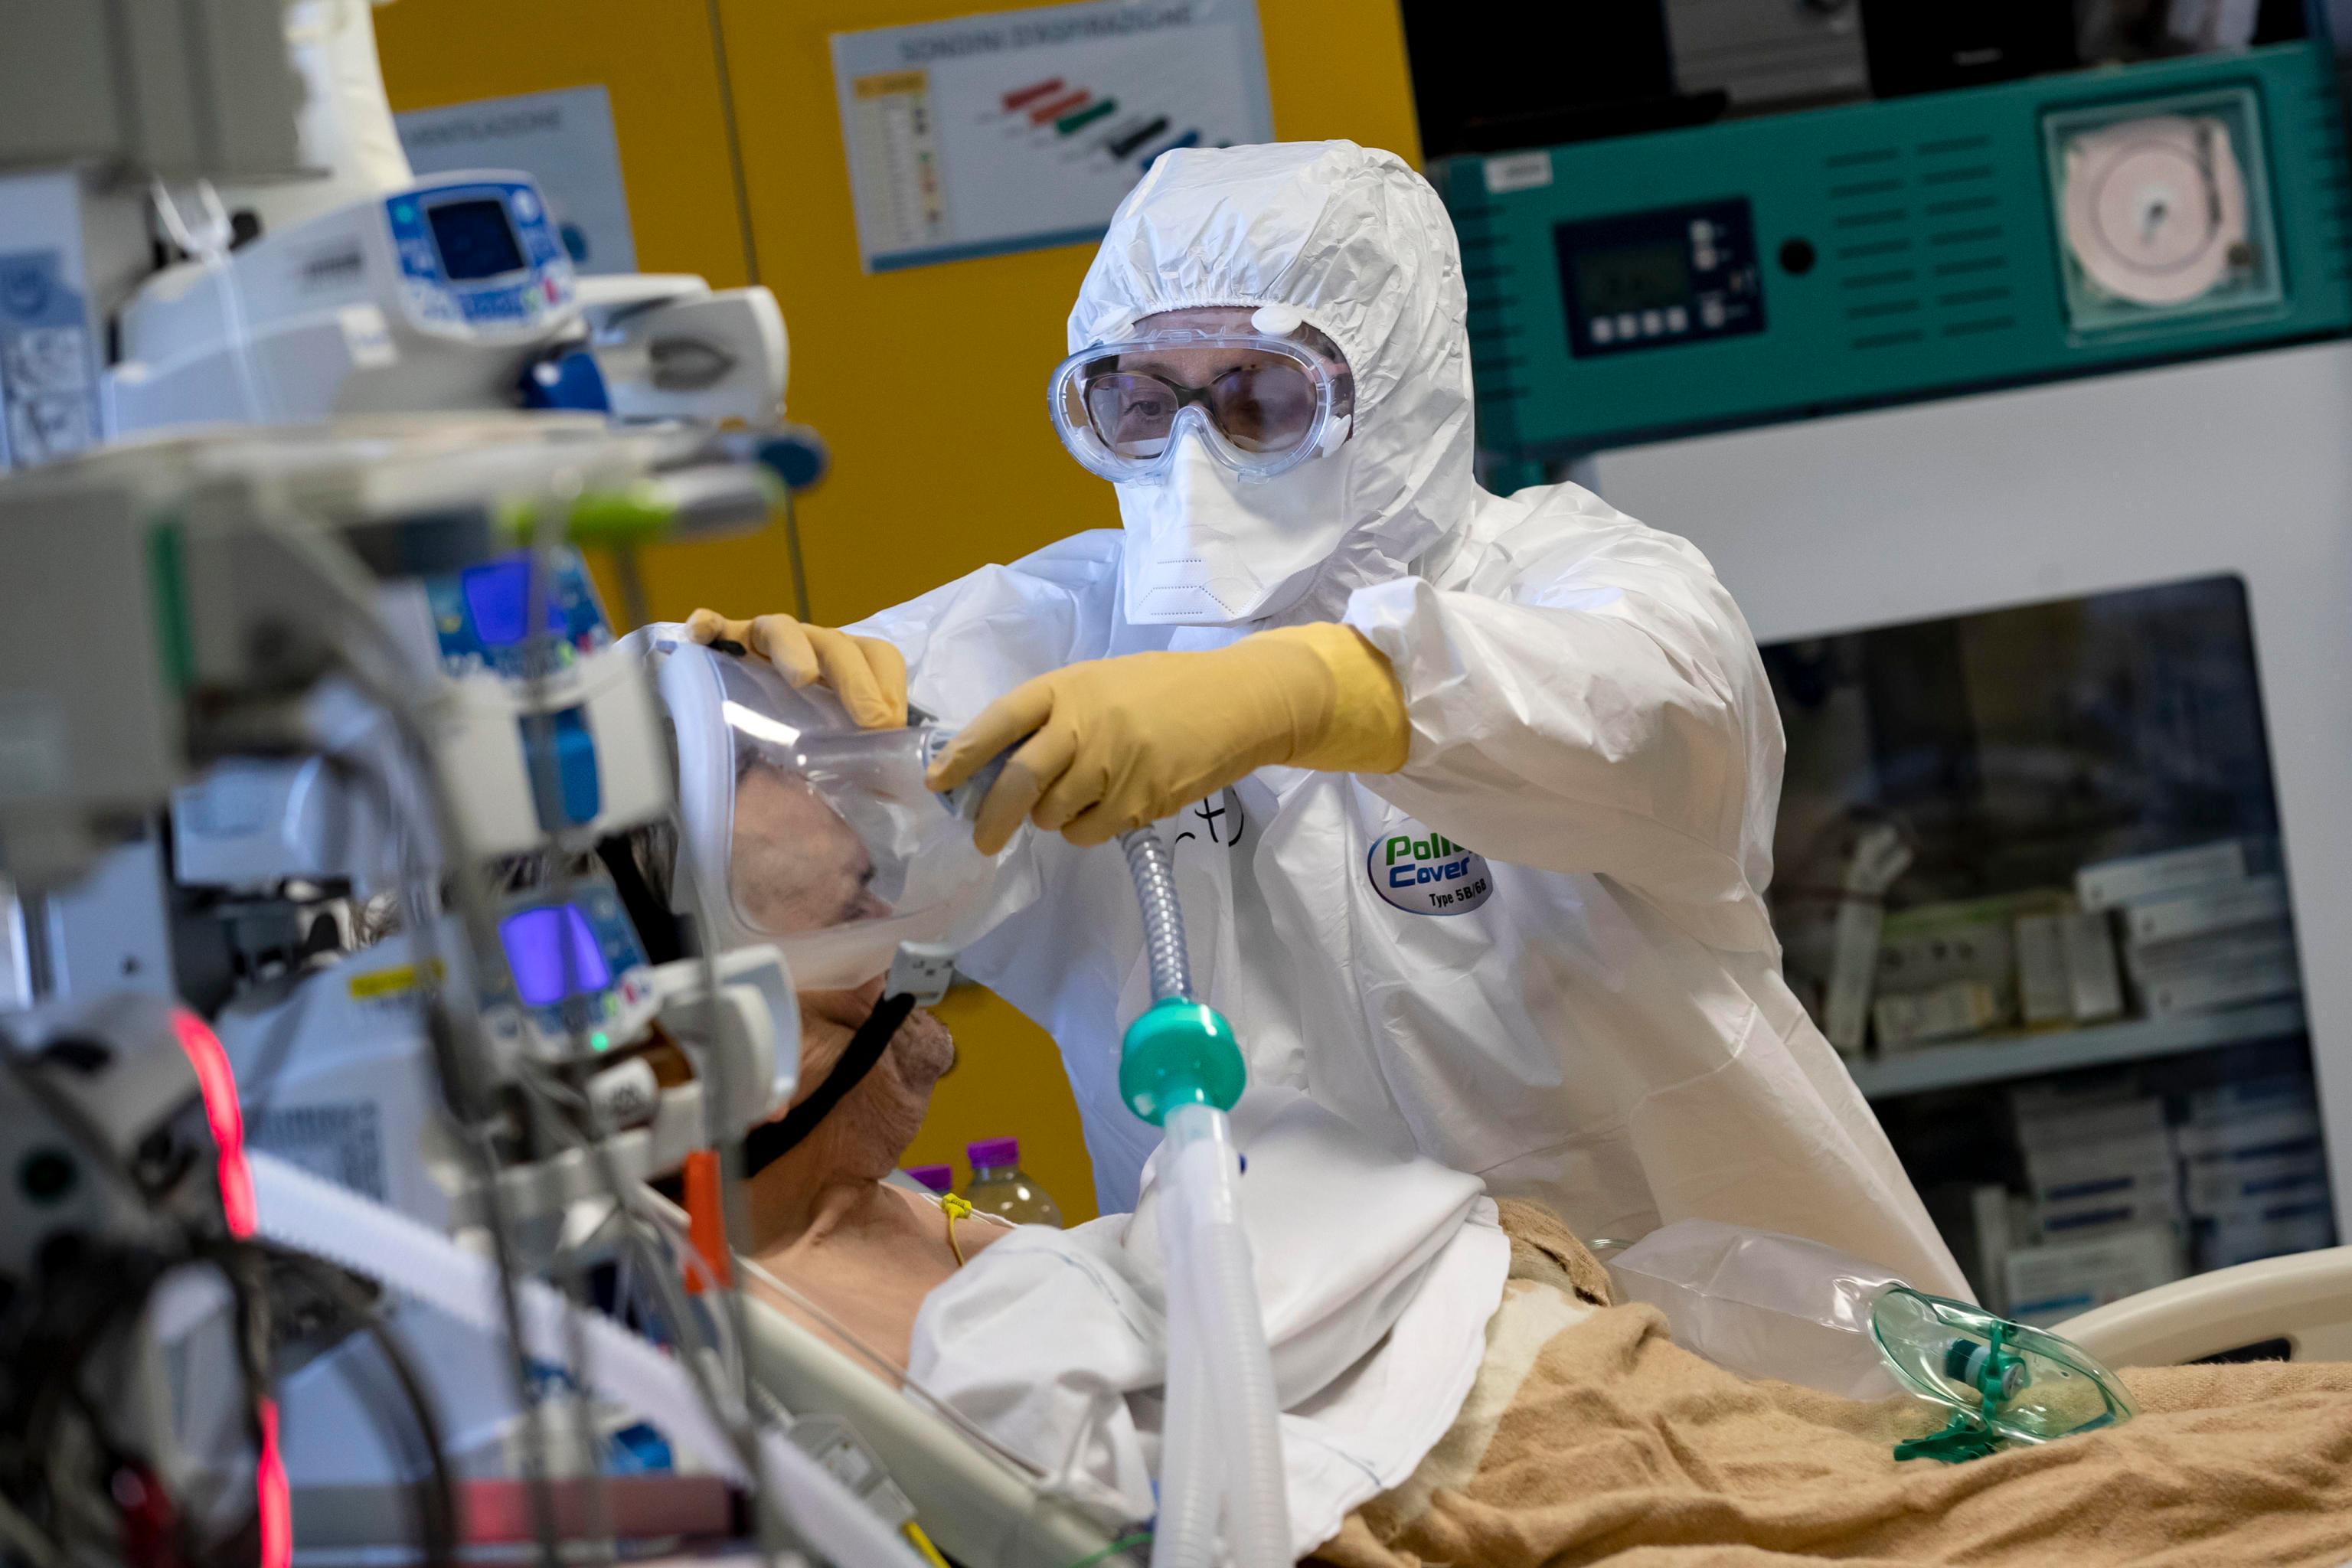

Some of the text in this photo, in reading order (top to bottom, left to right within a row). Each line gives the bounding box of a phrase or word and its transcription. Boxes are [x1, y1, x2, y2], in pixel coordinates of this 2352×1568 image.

[1390, 857, 1471, 888] Cover
[1429, 877, 1487, 908] Type 5B/6B
